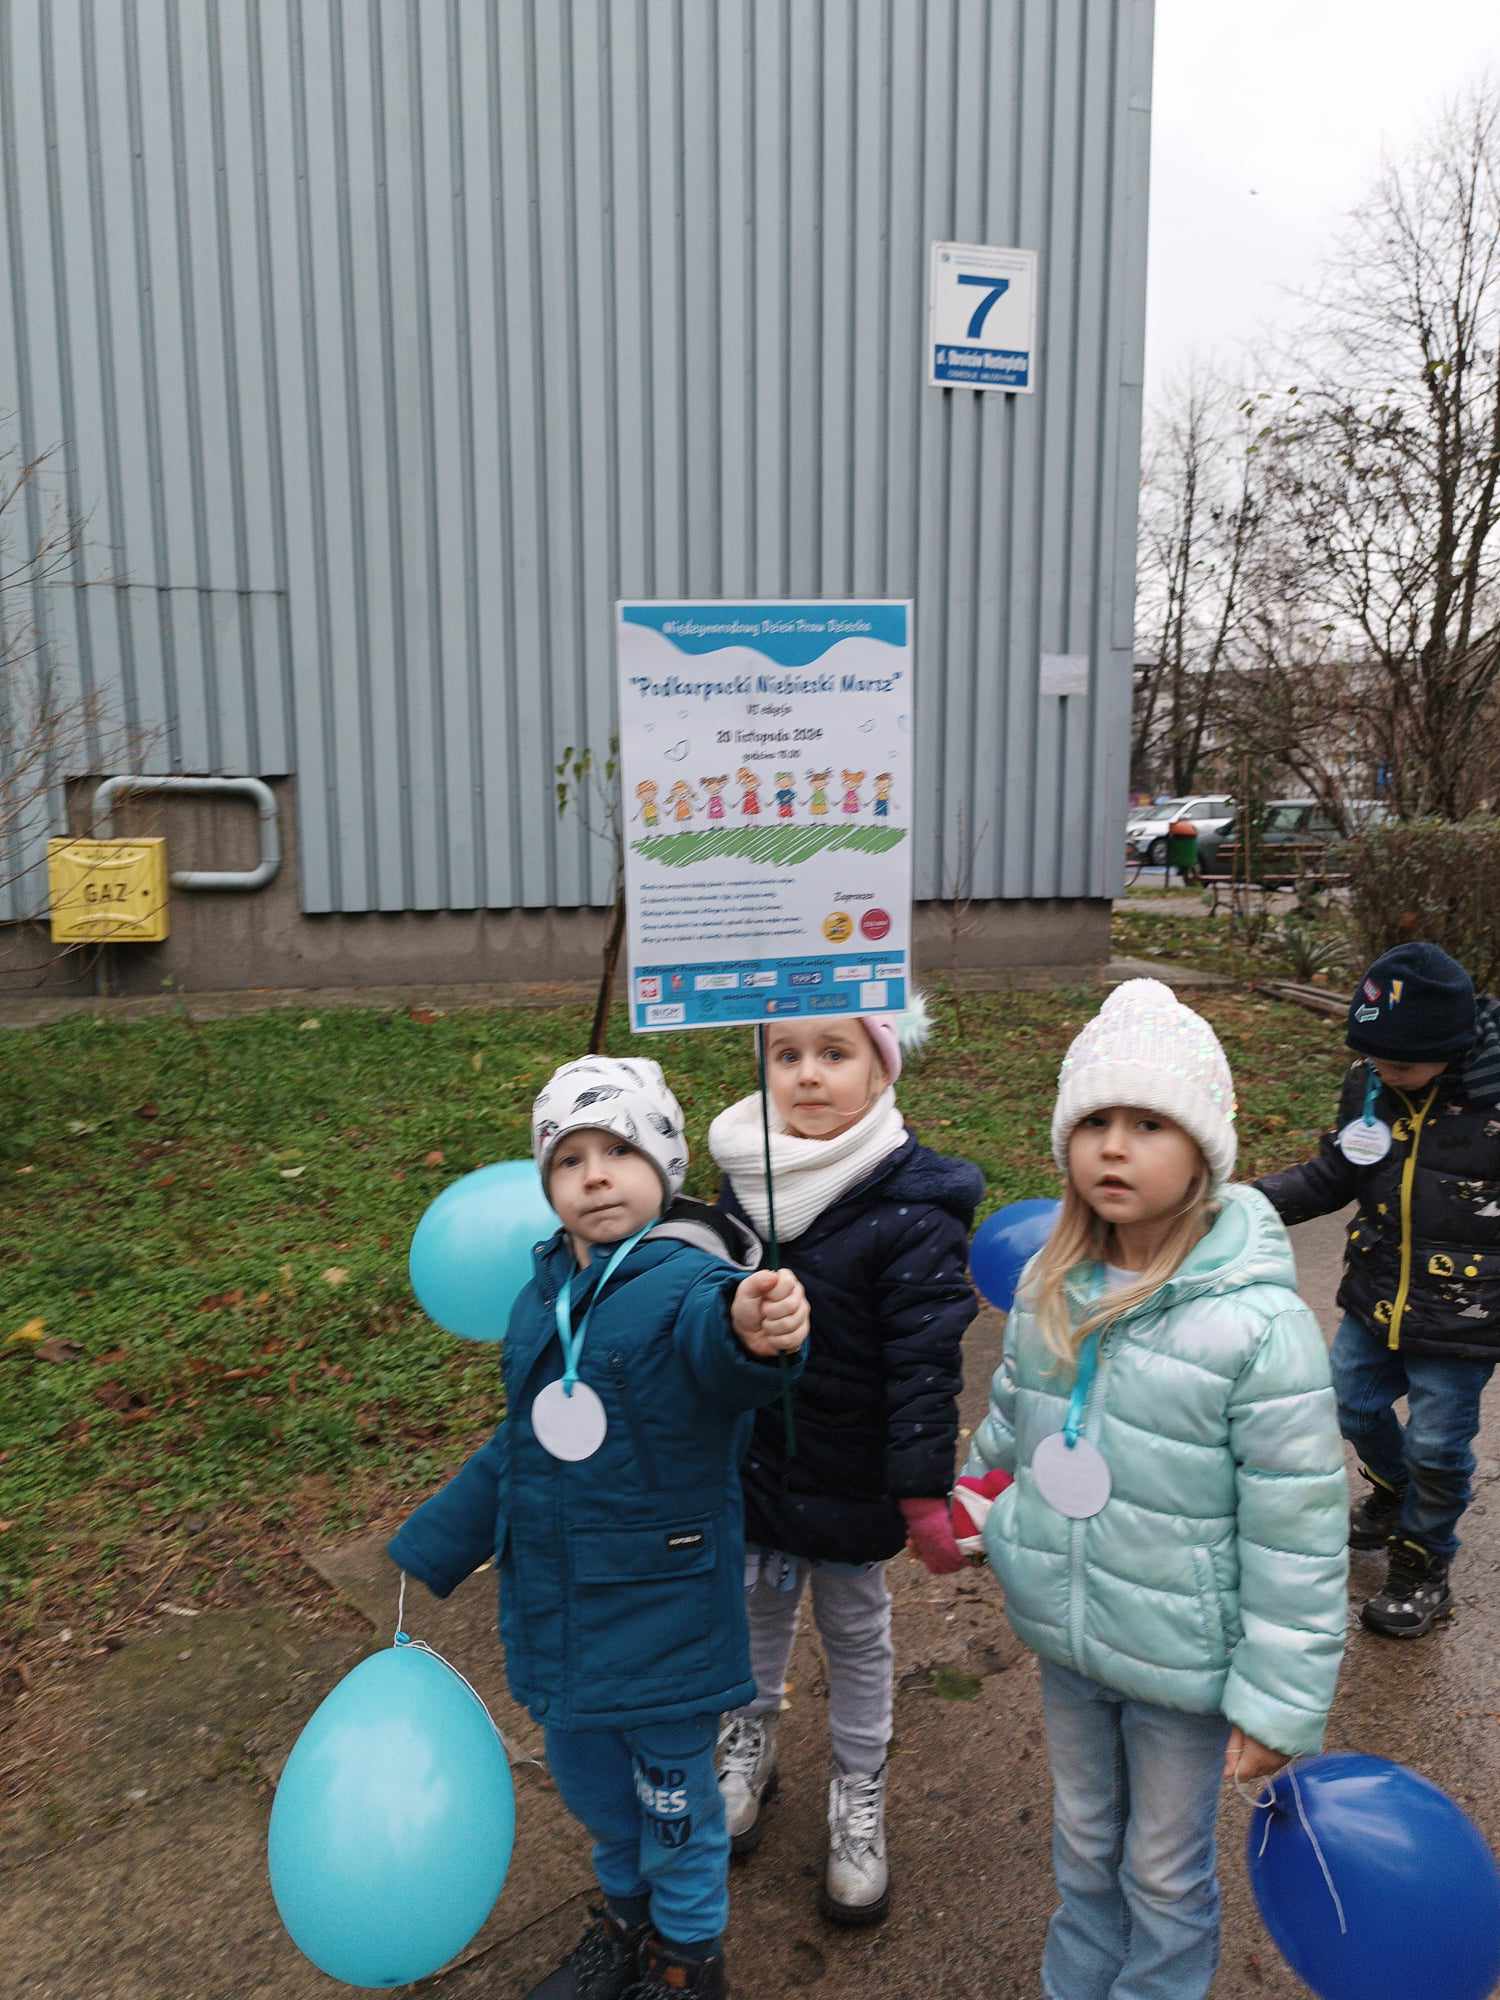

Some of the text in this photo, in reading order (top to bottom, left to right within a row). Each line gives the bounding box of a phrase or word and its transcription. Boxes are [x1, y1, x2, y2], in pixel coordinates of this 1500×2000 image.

[957, 273, 1010, 339] 7
[755, 672, 834, 694] Niebieski
[735, 727, 790, 746] listopada
[792, 728, 824, 742] 2024
[83, 883, 128, 903] GAZ
